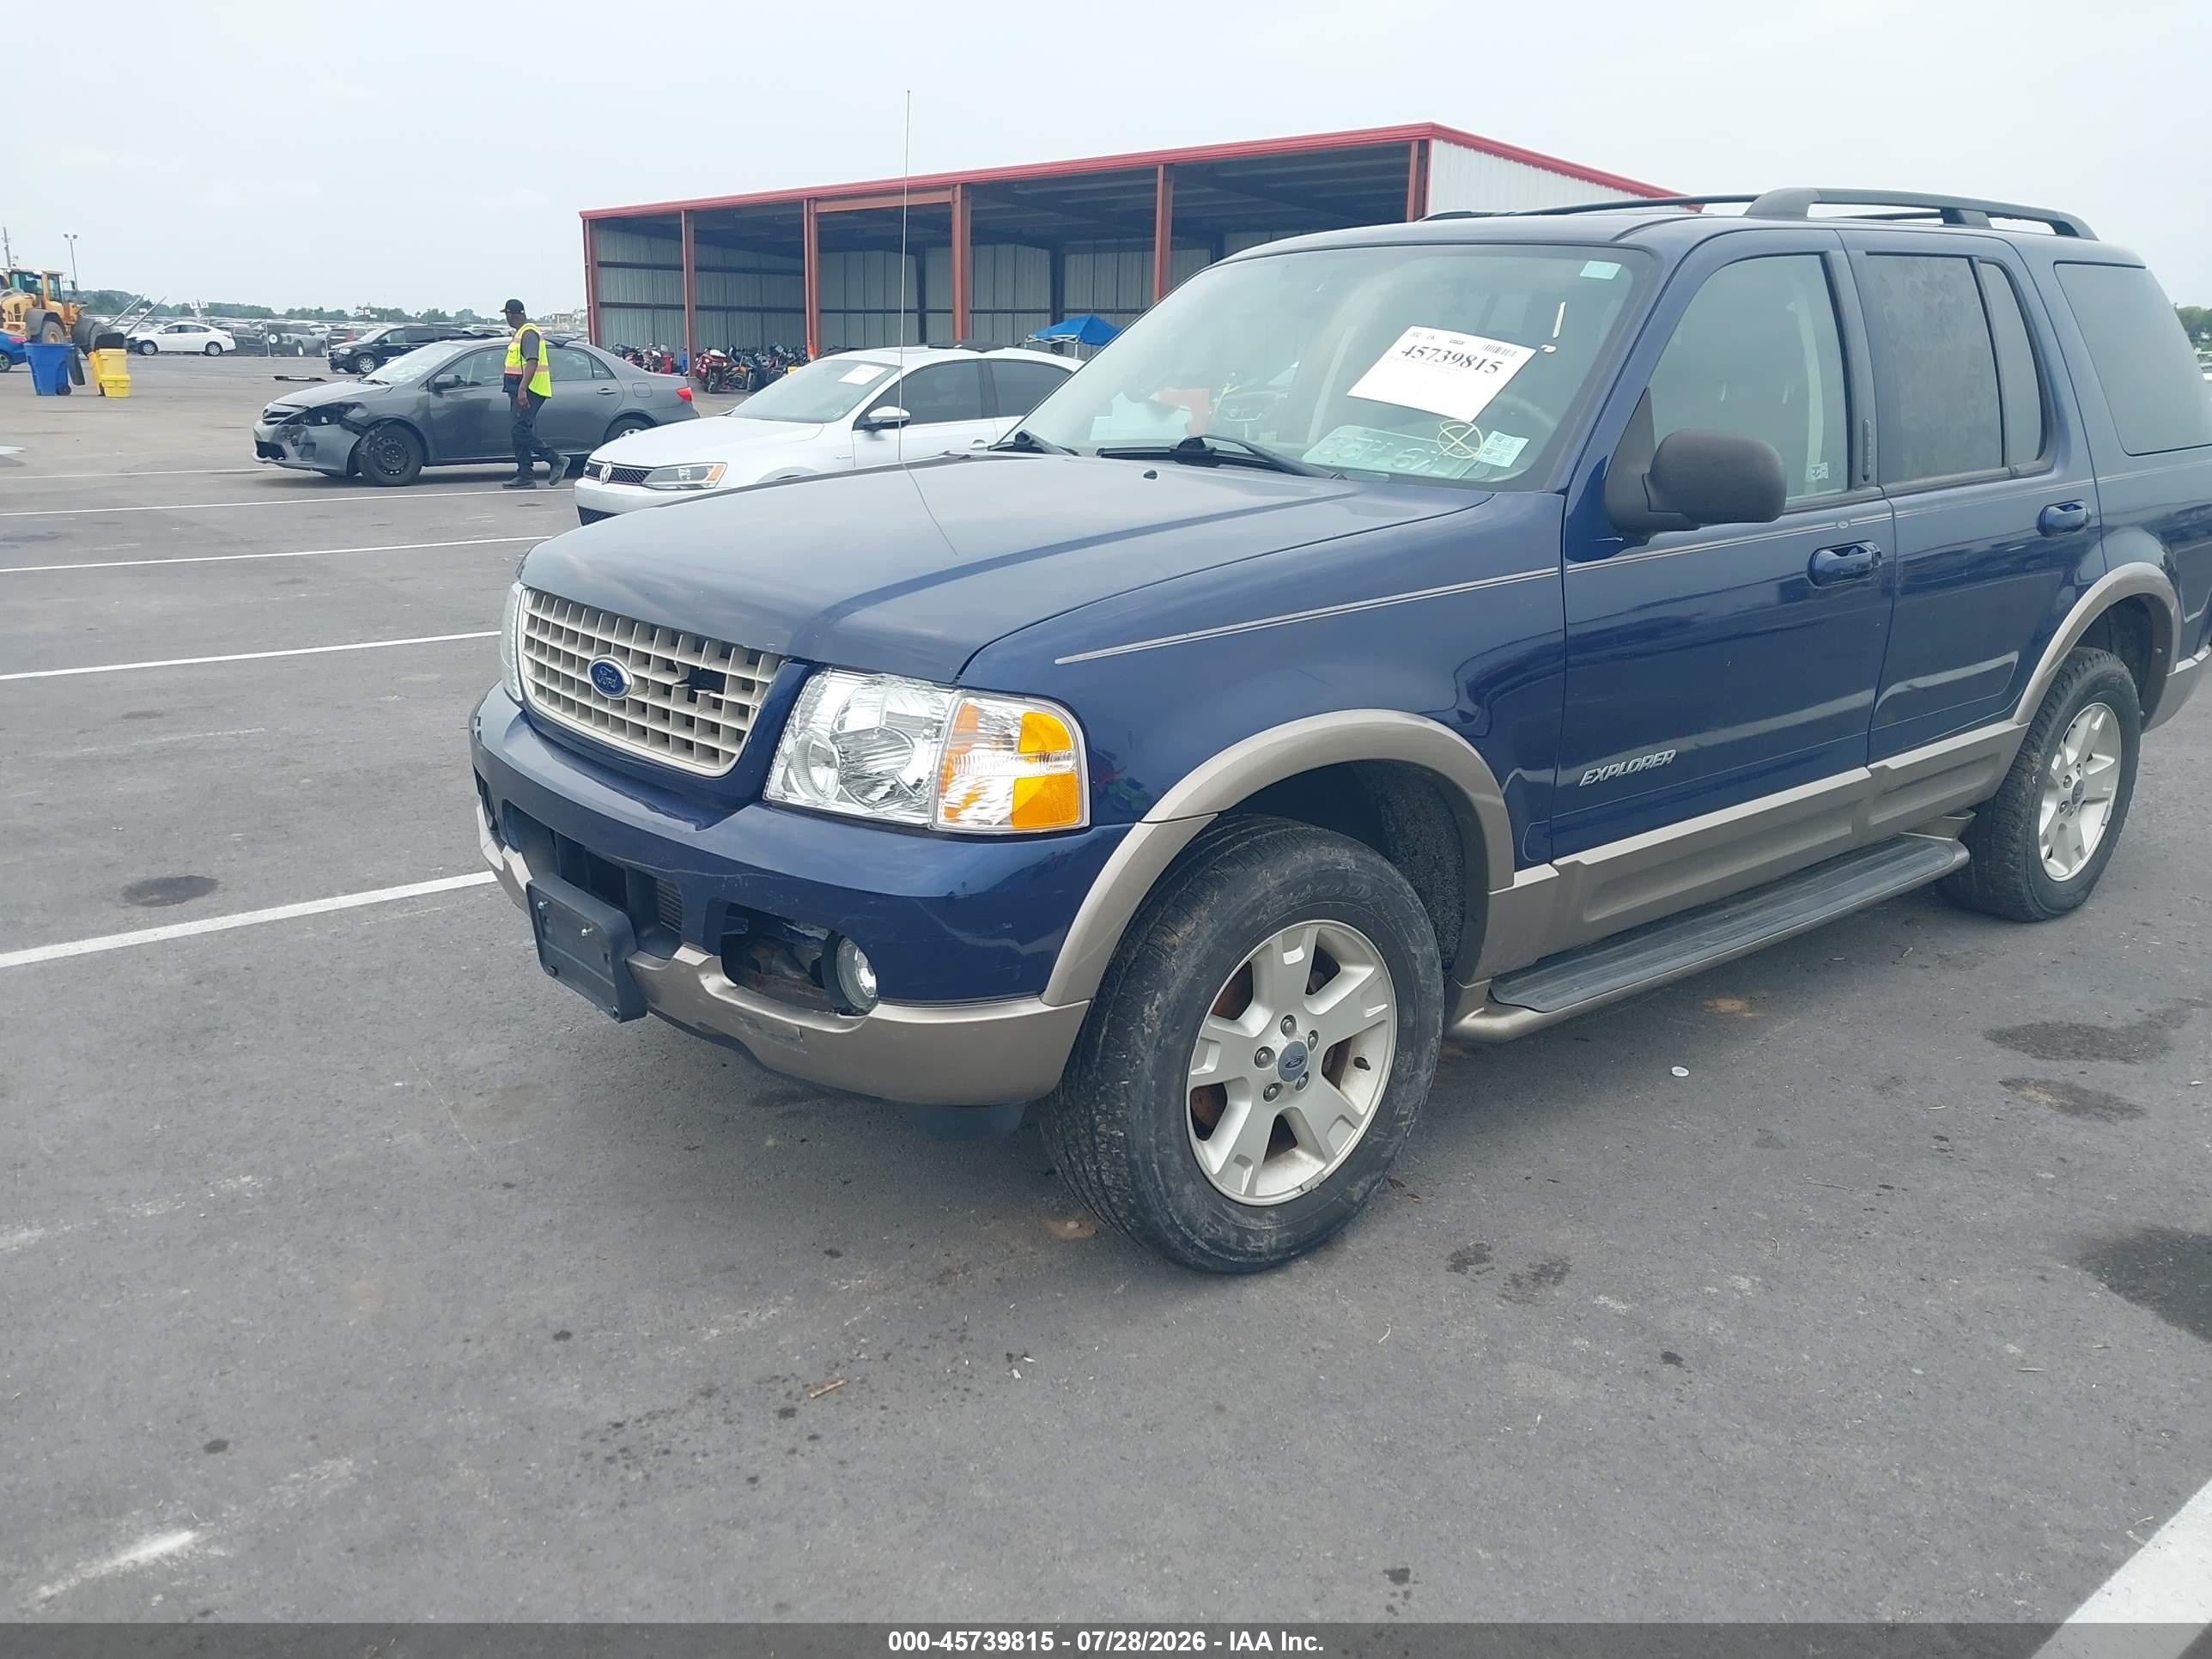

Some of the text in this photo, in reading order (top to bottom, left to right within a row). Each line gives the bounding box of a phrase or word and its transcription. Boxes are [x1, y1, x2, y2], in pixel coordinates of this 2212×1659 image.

[1401, 344, 1504, 374] 45739815
[597, 665, 619, 689] Ford
[1578, 749, 1677, 787] EXPLORER
